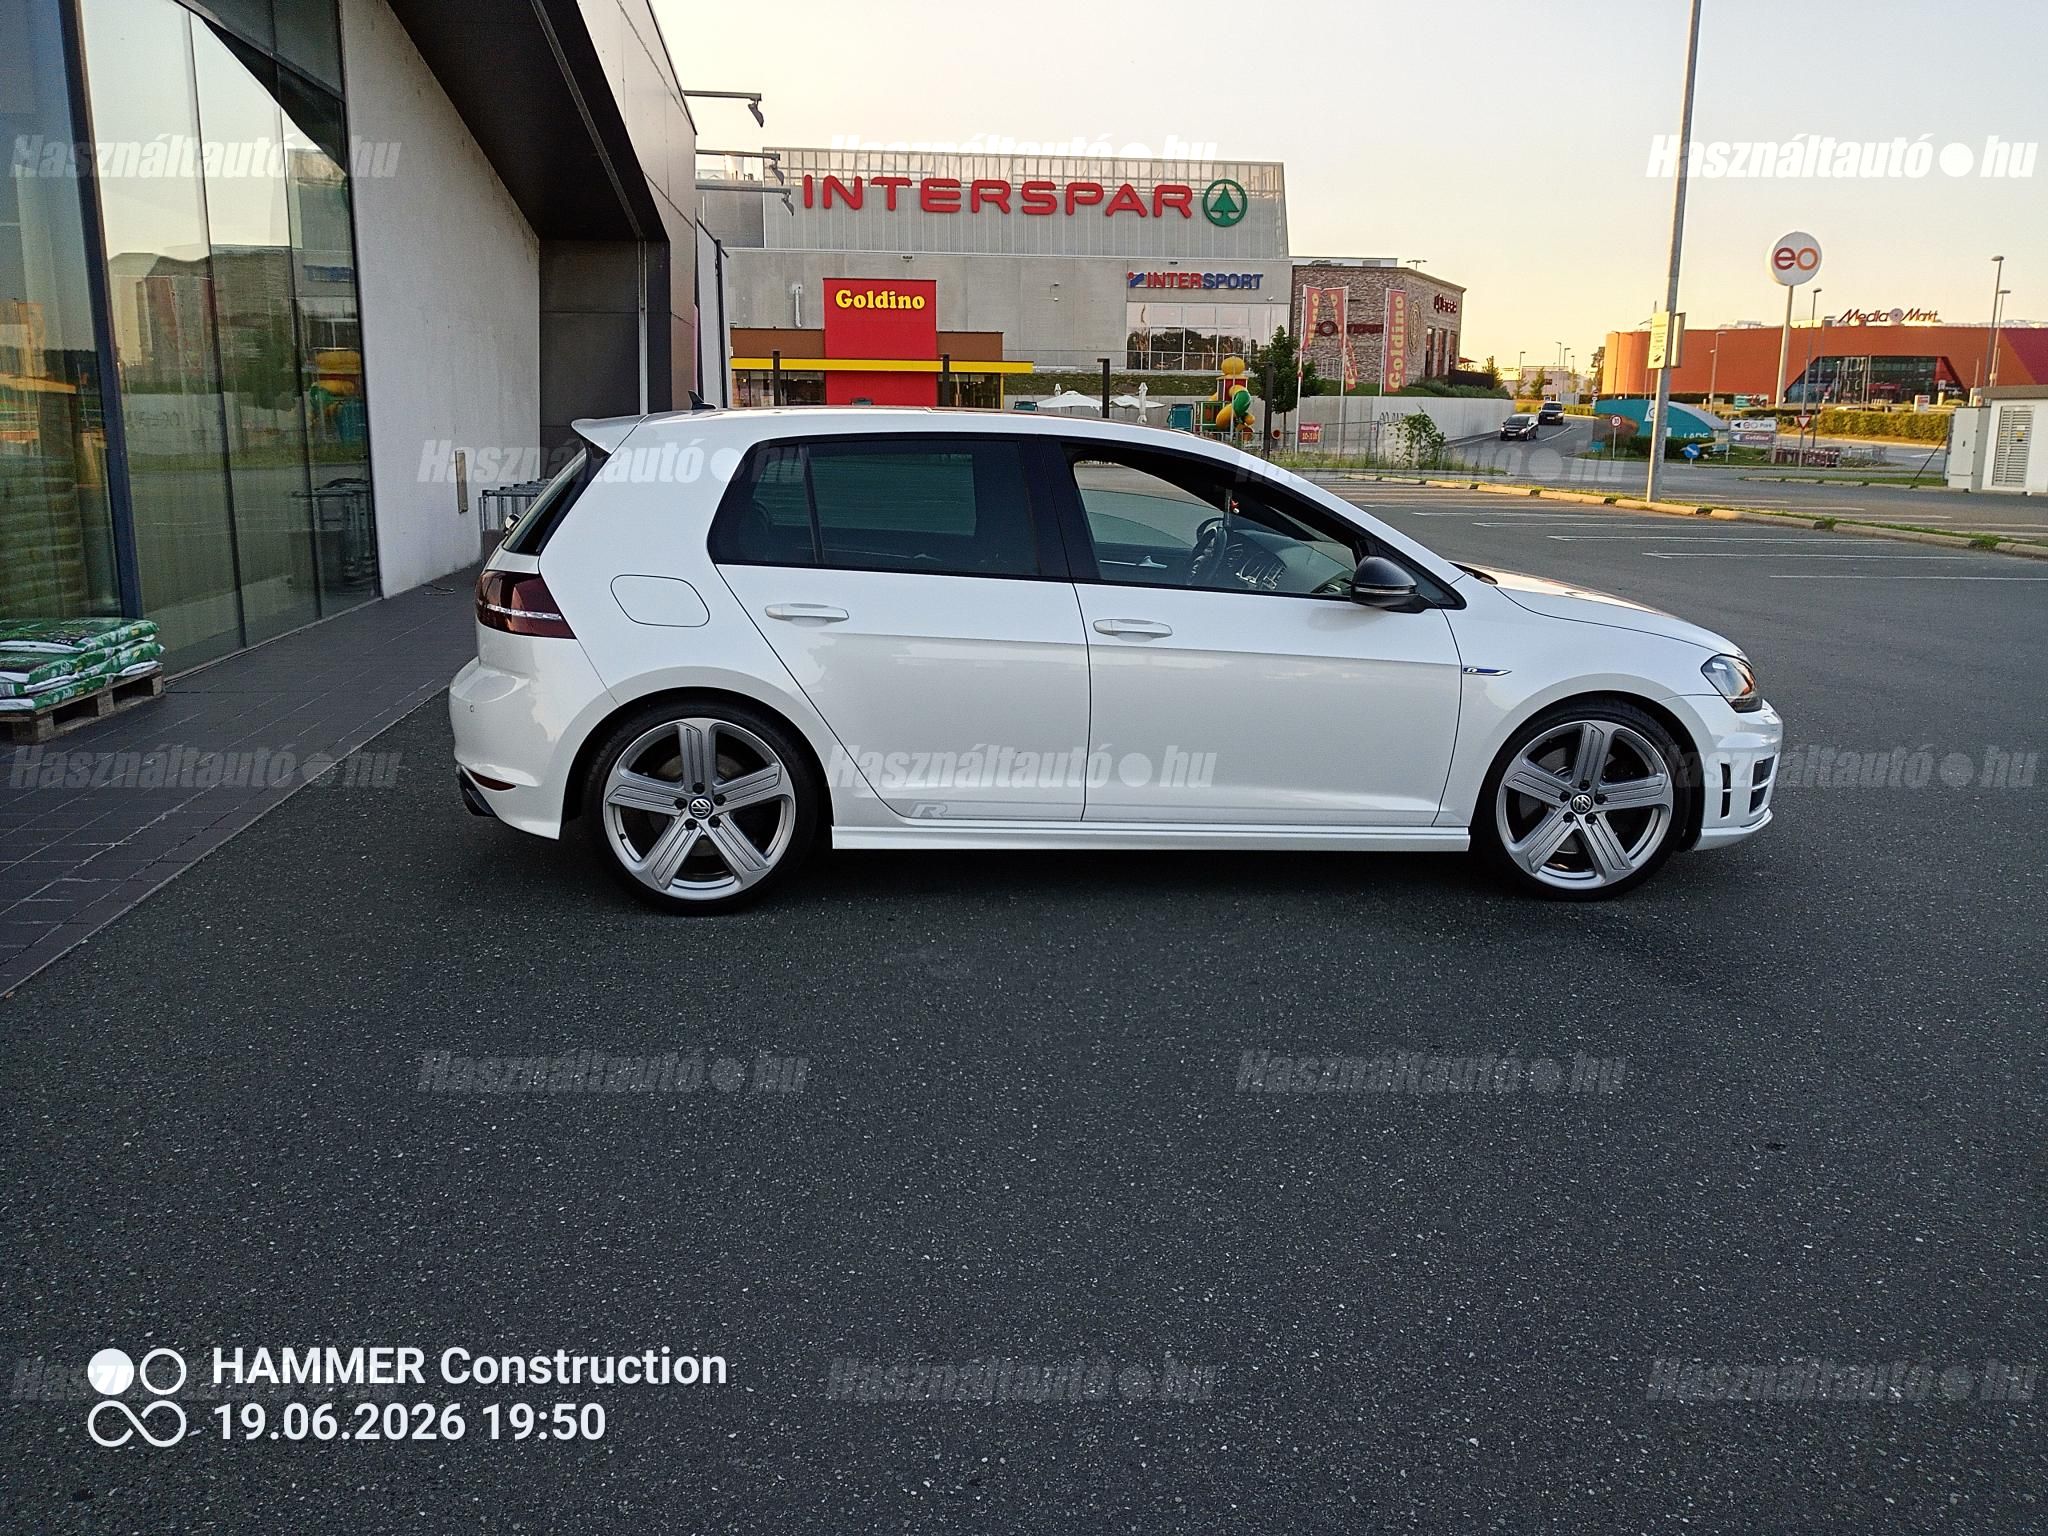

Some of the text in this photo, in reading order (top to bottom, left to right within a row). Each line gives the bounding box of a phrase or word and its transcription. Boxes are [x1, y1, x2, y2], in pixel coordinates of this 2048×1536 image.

[803, 174, 1193, 218] INTERSPAR
[1773, 247, 1819, 271] eo
[1146, 272, 1264, 289] INTERSPORT
[835, 289, 925, 311] Goldino
[1838, 308, 1939, 323] Media Markt
[1388, 295, 1404, 389] Goldino
